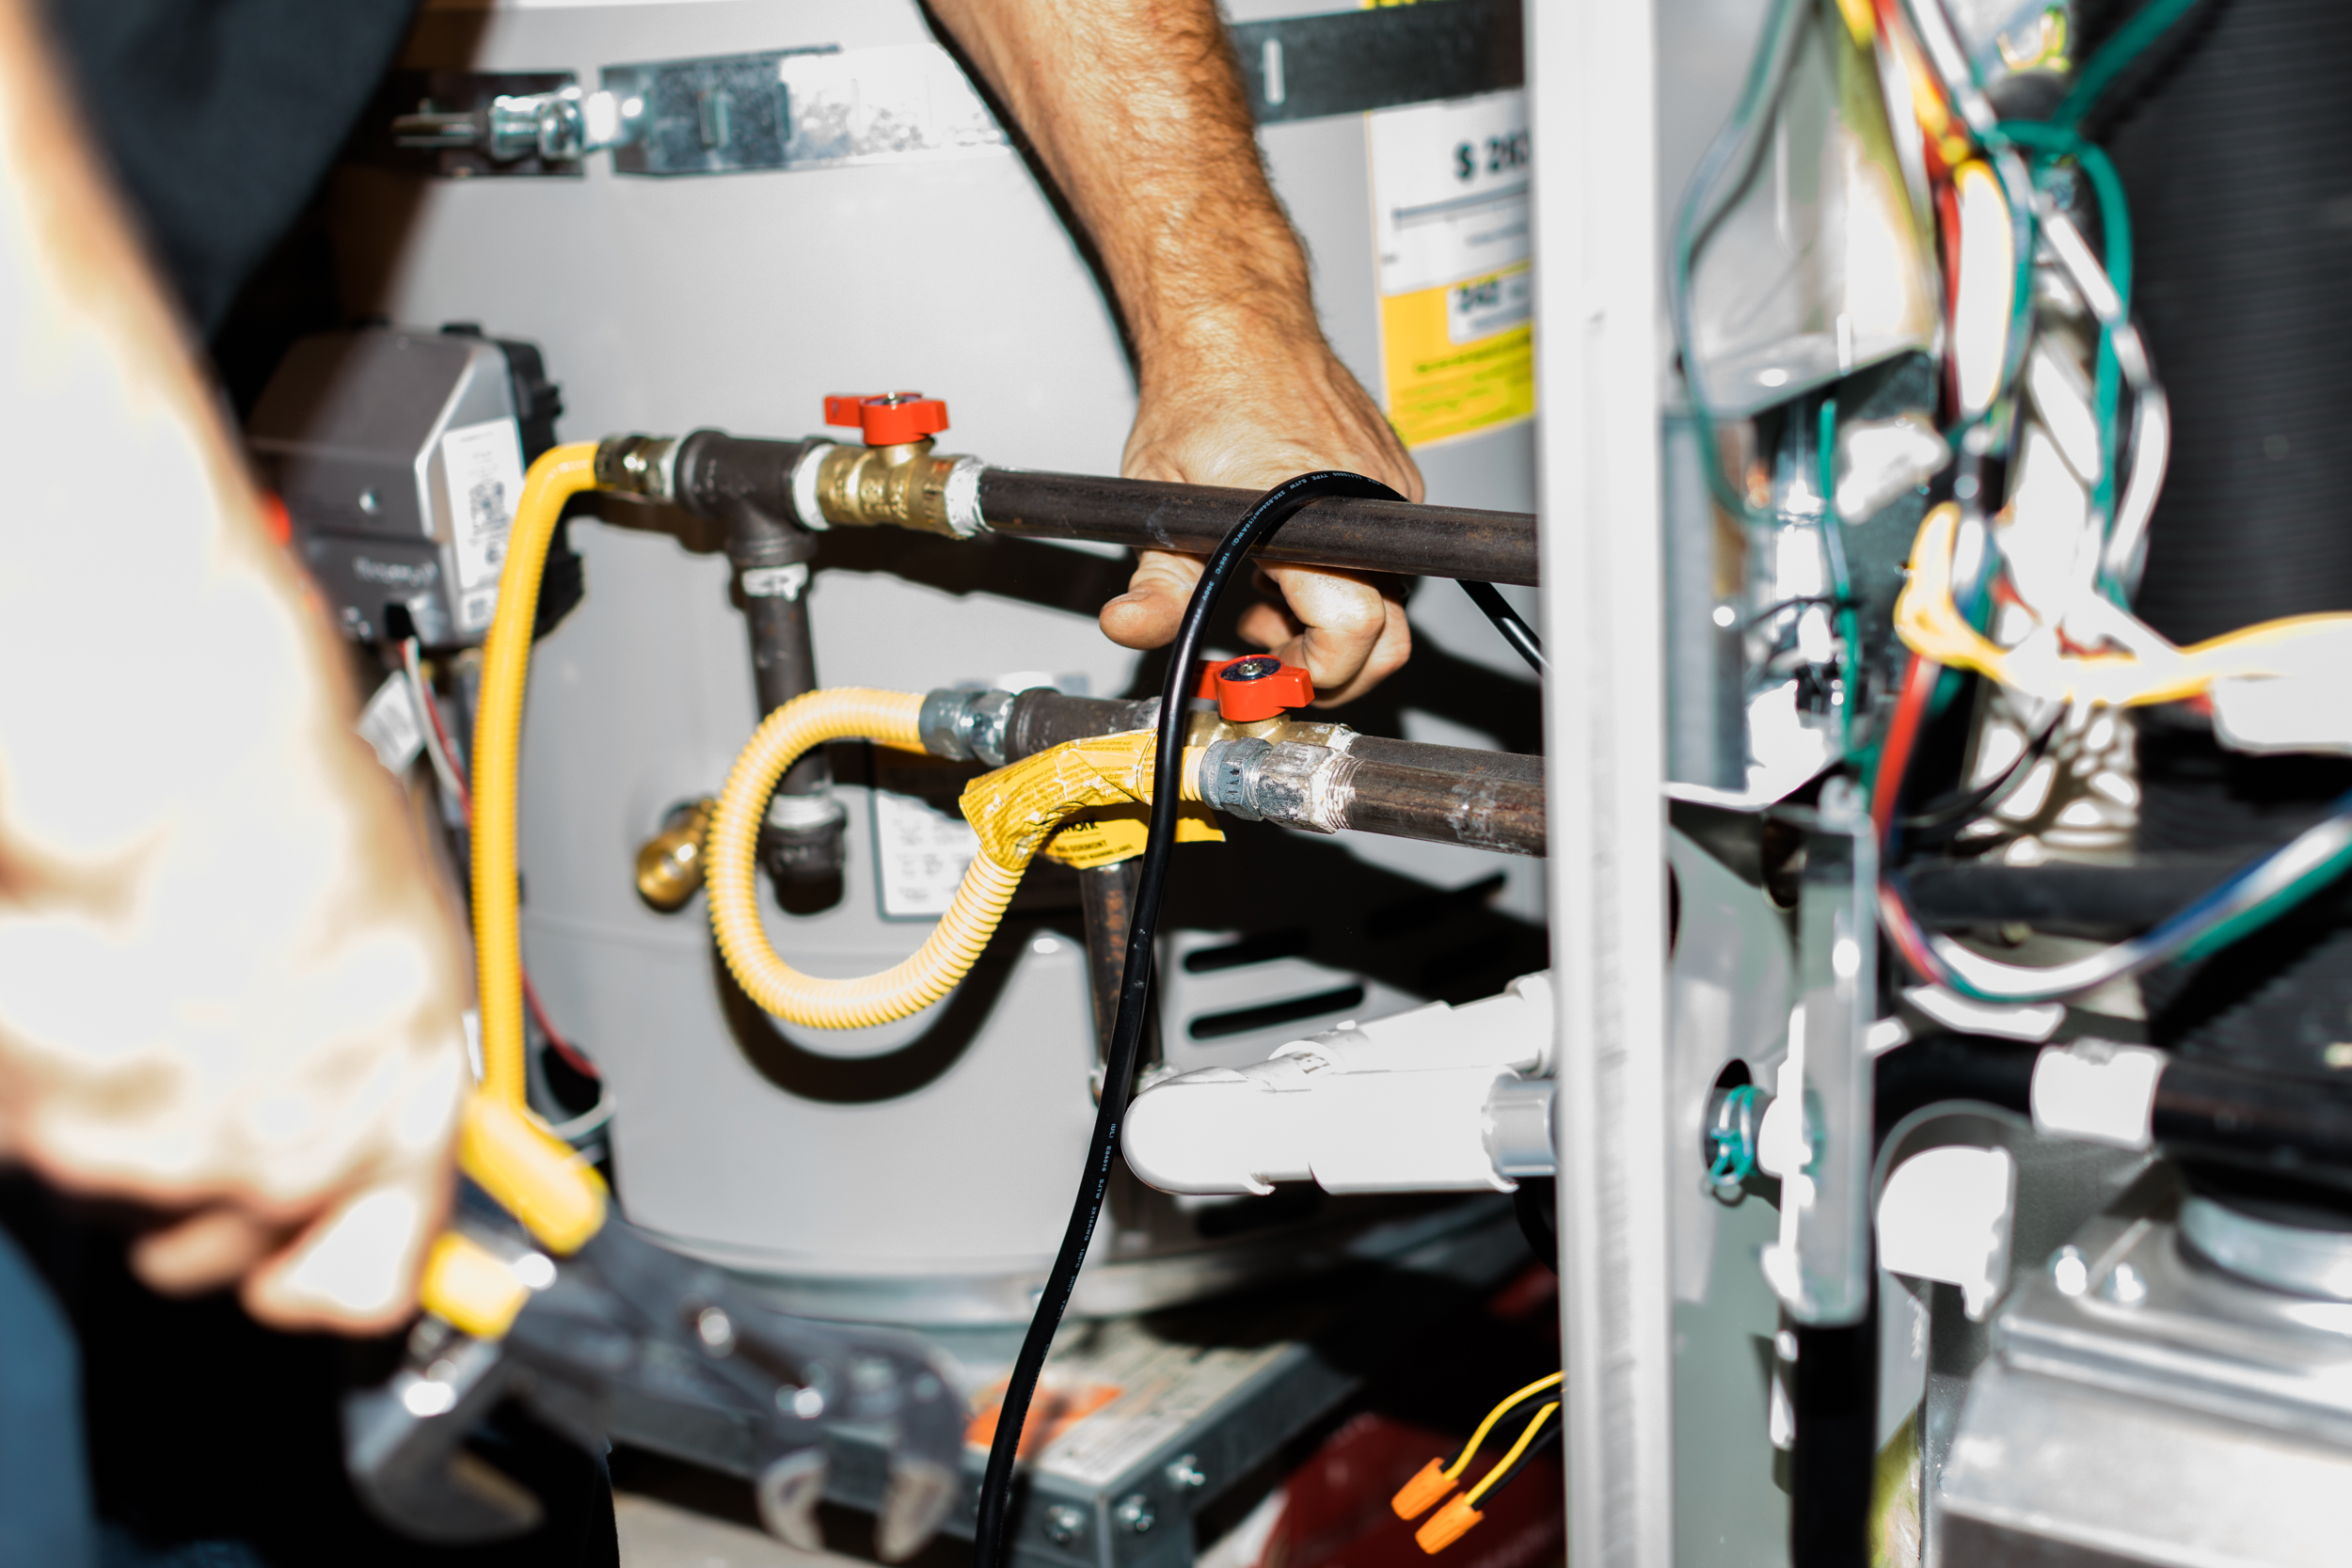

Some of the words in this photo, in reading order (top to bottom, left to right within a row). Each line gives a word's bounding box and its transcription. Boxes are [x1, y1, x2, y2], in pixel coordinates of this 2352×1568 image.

[1289, 478, 1308, 490] SJTW
[1214, 551, 1231, 576] 105°C
[1201, 580, 1216, 601] 300V
[1095, 1178, 1104, 1199] SJTW
